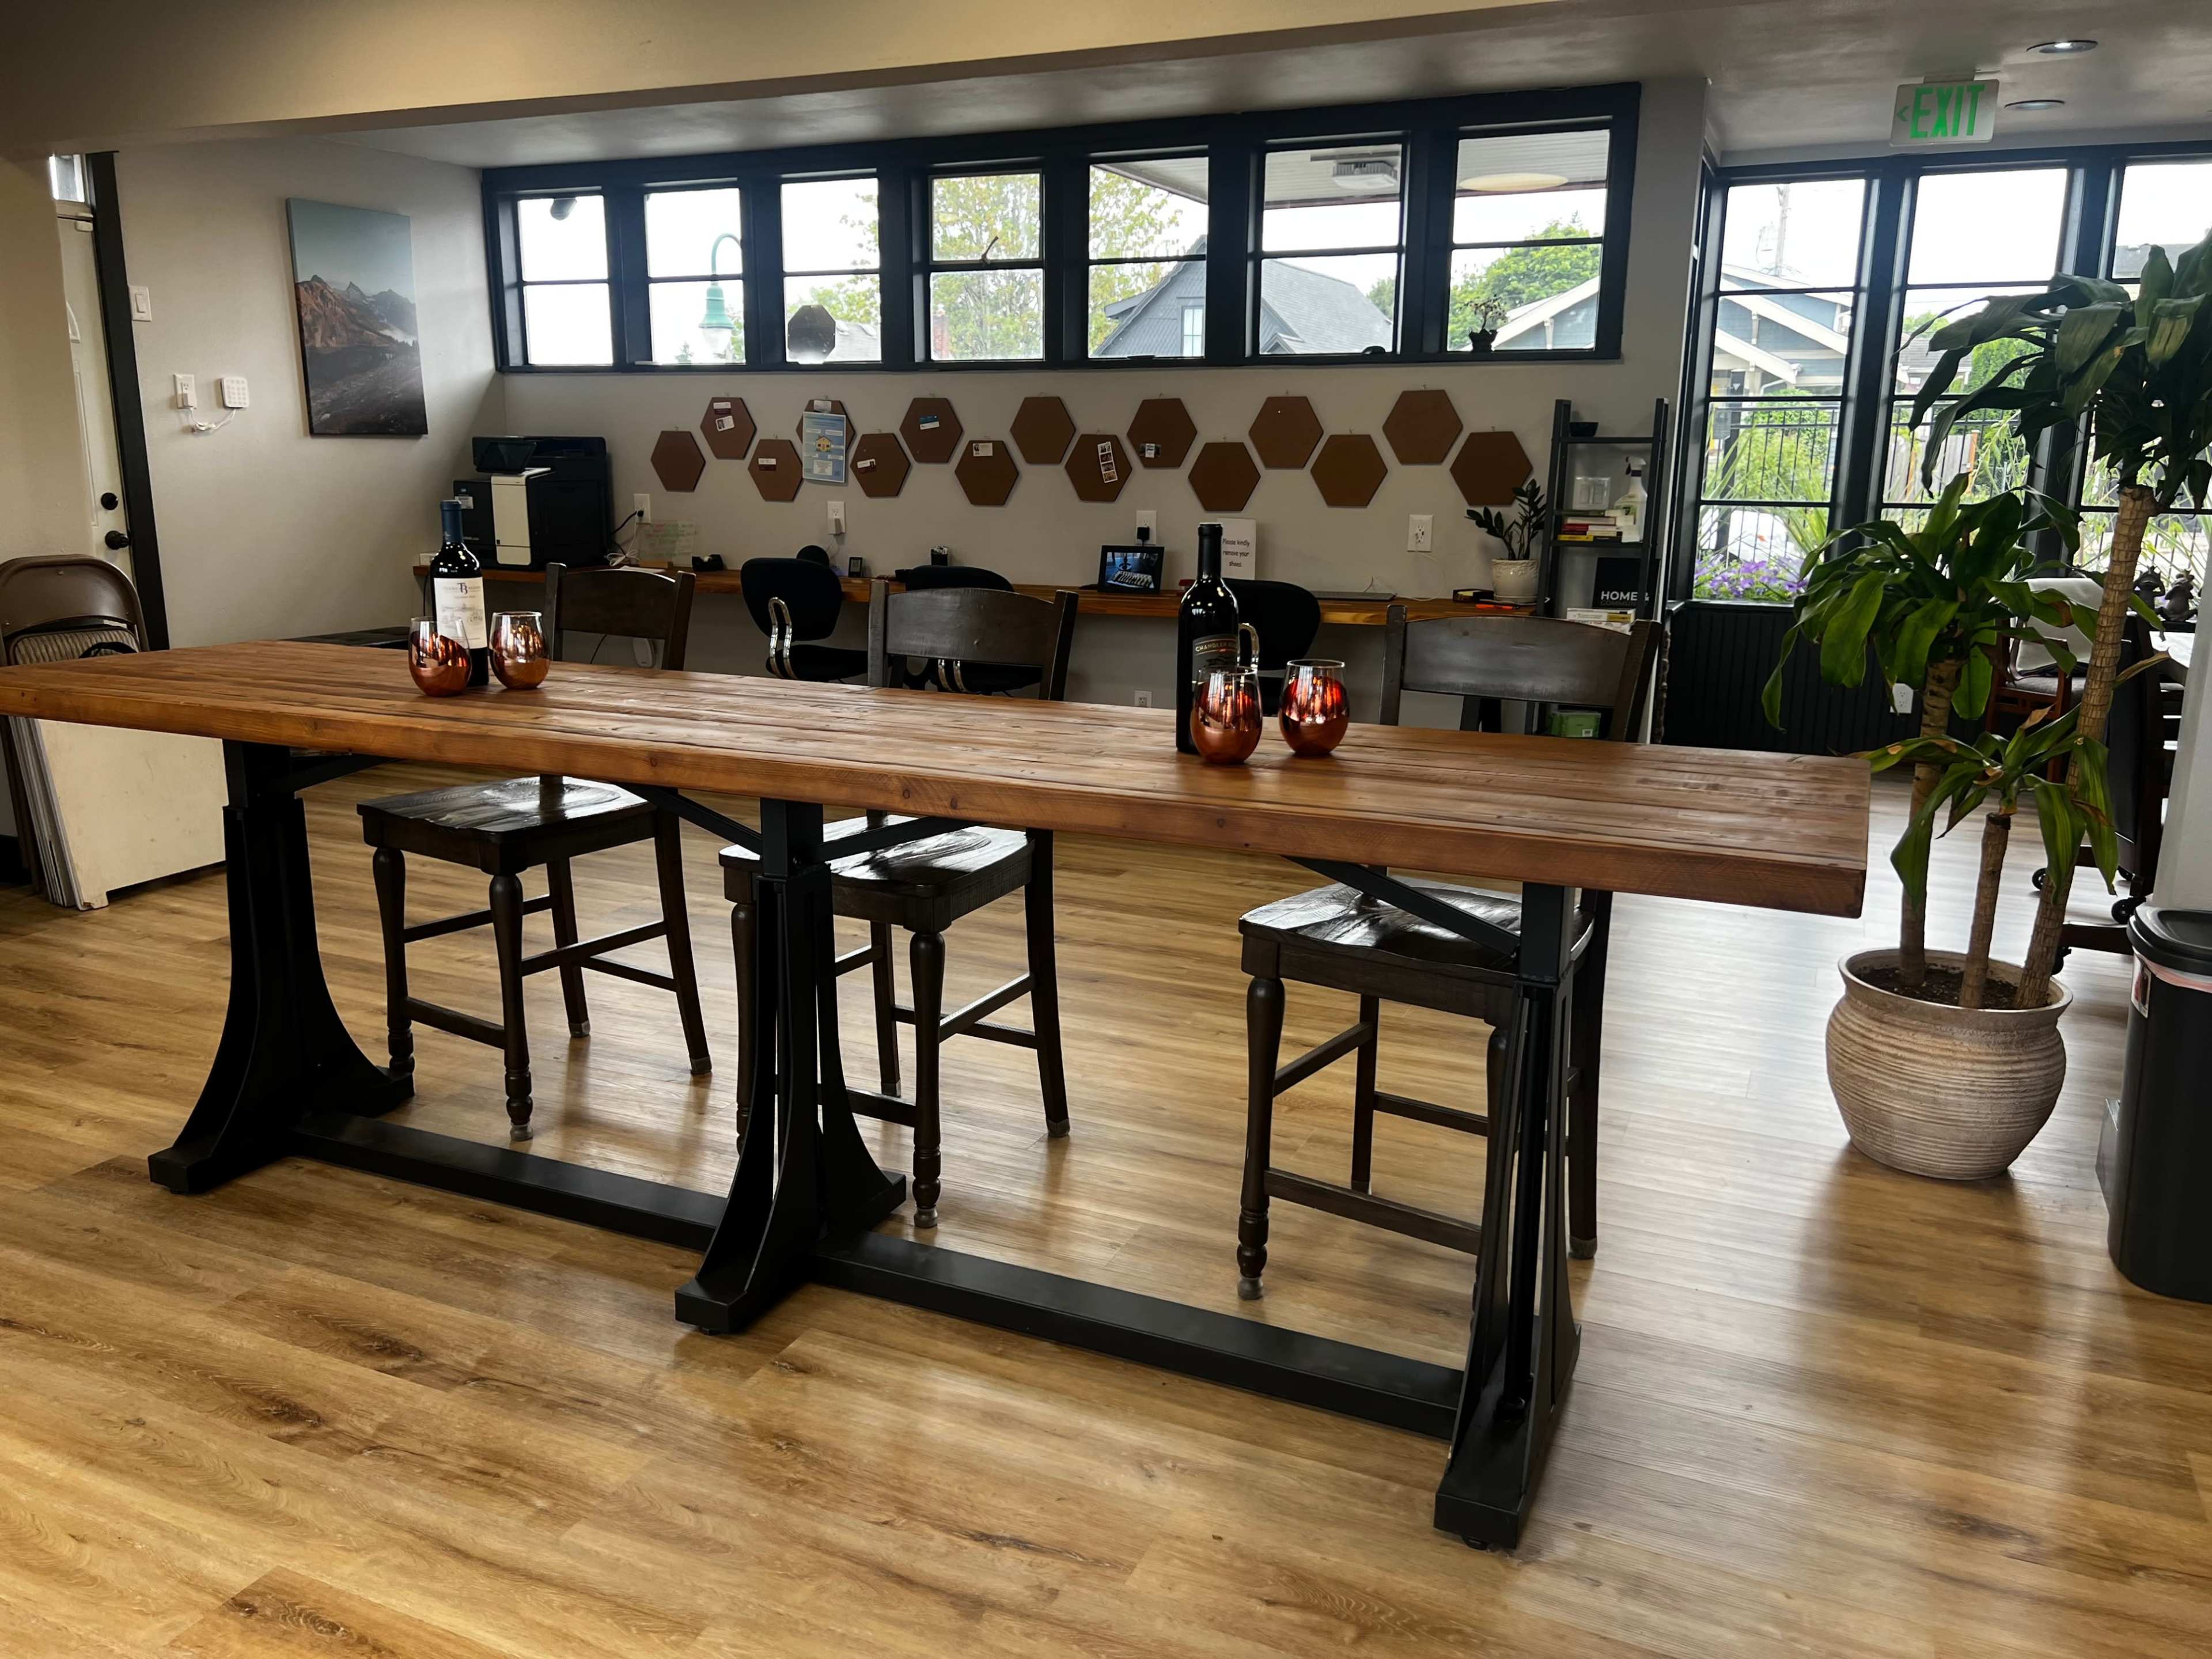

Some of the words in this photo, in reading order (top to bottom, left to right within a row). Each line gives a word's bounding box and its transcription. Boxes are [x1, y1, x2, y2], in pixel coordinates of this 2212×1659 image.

[1910, 84, 1985, 138] EXIT
[1237, 539, 1250, 548] kindly
[1600, 591, 1638, 601] HOME
